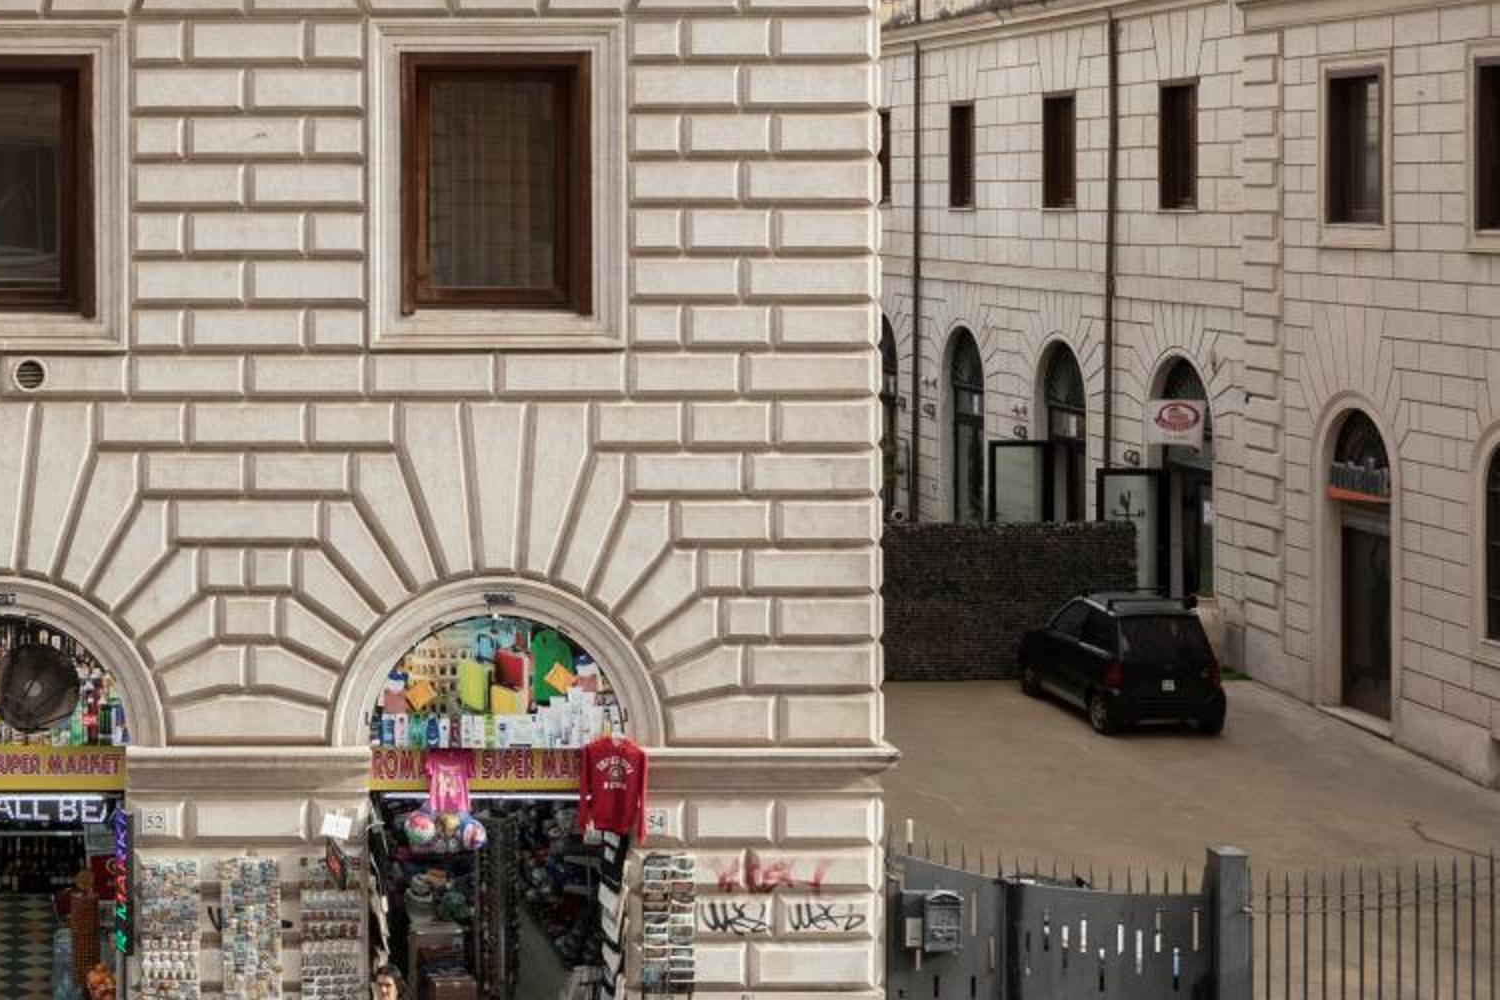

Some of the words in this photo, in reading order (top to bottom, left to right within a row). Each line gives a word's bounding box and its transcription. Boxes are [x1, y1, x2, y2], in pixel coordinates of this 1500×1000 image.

[371, 749, 429, 781] ROM
[480, 749, 535, 781] SUPER
[146, 813, 165, 830] 52
[647, 814, 665, 829] 54
